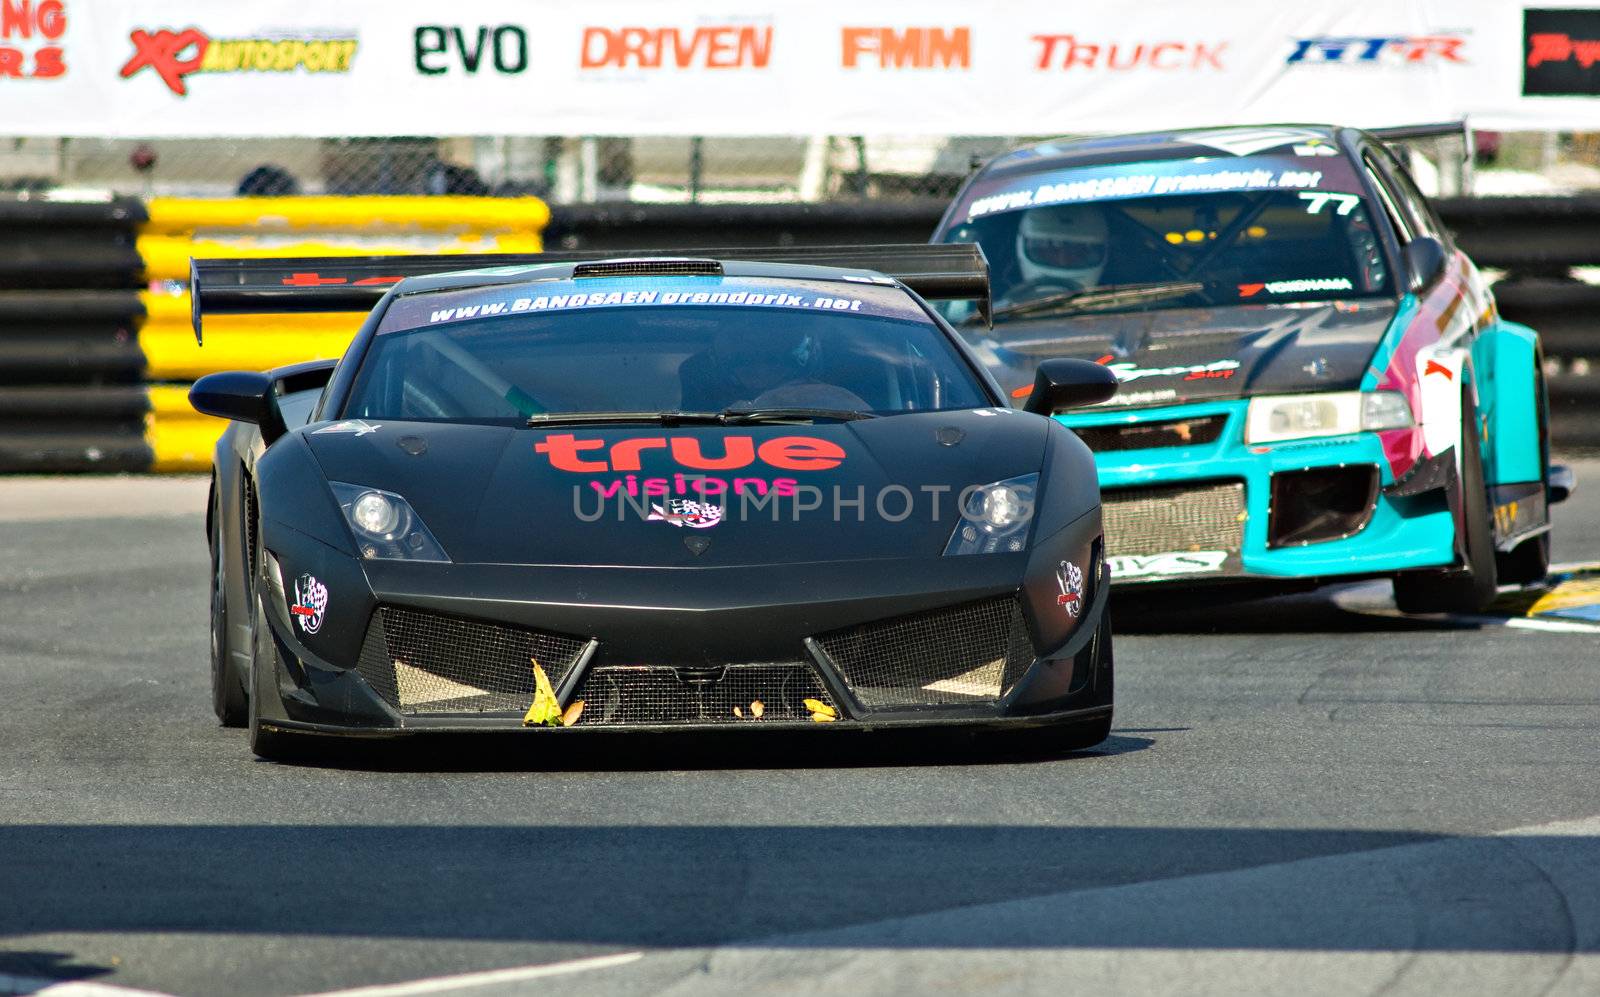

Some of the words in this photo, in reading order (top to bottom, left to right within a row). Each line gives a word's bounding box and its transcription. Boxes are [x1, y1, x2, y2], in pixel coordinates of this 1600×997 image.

[200, 38, 358, 73] AUTOSPORT
[580, 25, 773, 69] DRIVEN
[842, 27, 970, 69] FMM
[1298, 191, 1361, 216] 77
[535, 434, 847, 473] true
[590, 473, 798, 498] visions
